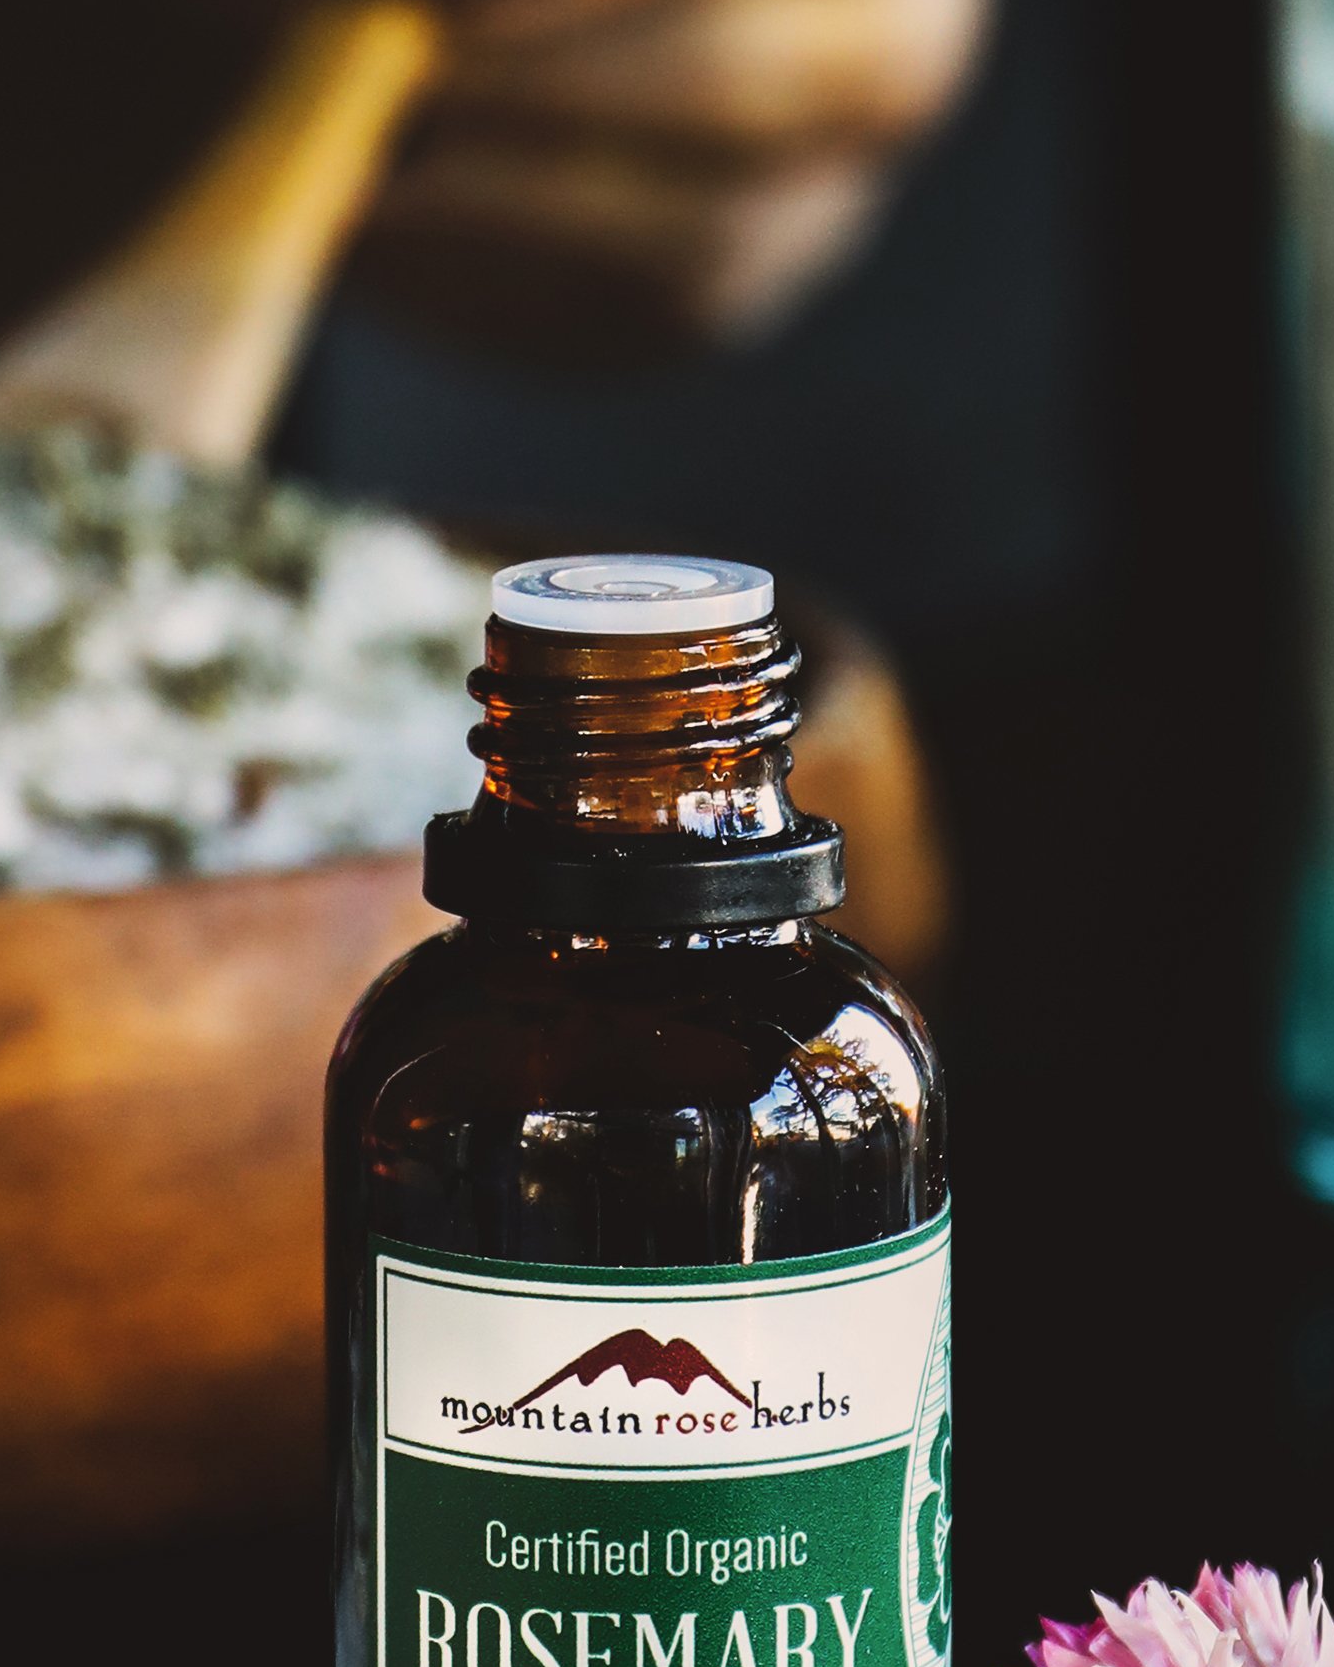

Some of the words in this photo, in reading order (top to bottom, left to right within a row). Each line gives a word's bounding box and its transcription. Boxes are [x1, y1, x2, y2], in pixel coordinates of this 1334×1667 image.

[441, 1394, 642, 1434] mountain
[655, 1411, 739, 1435] rose
[751, 1372, 851, 1429] herbs
[485, 1520, 649, 1576] Certified
[665, 1525, 808, 1585] Organic
